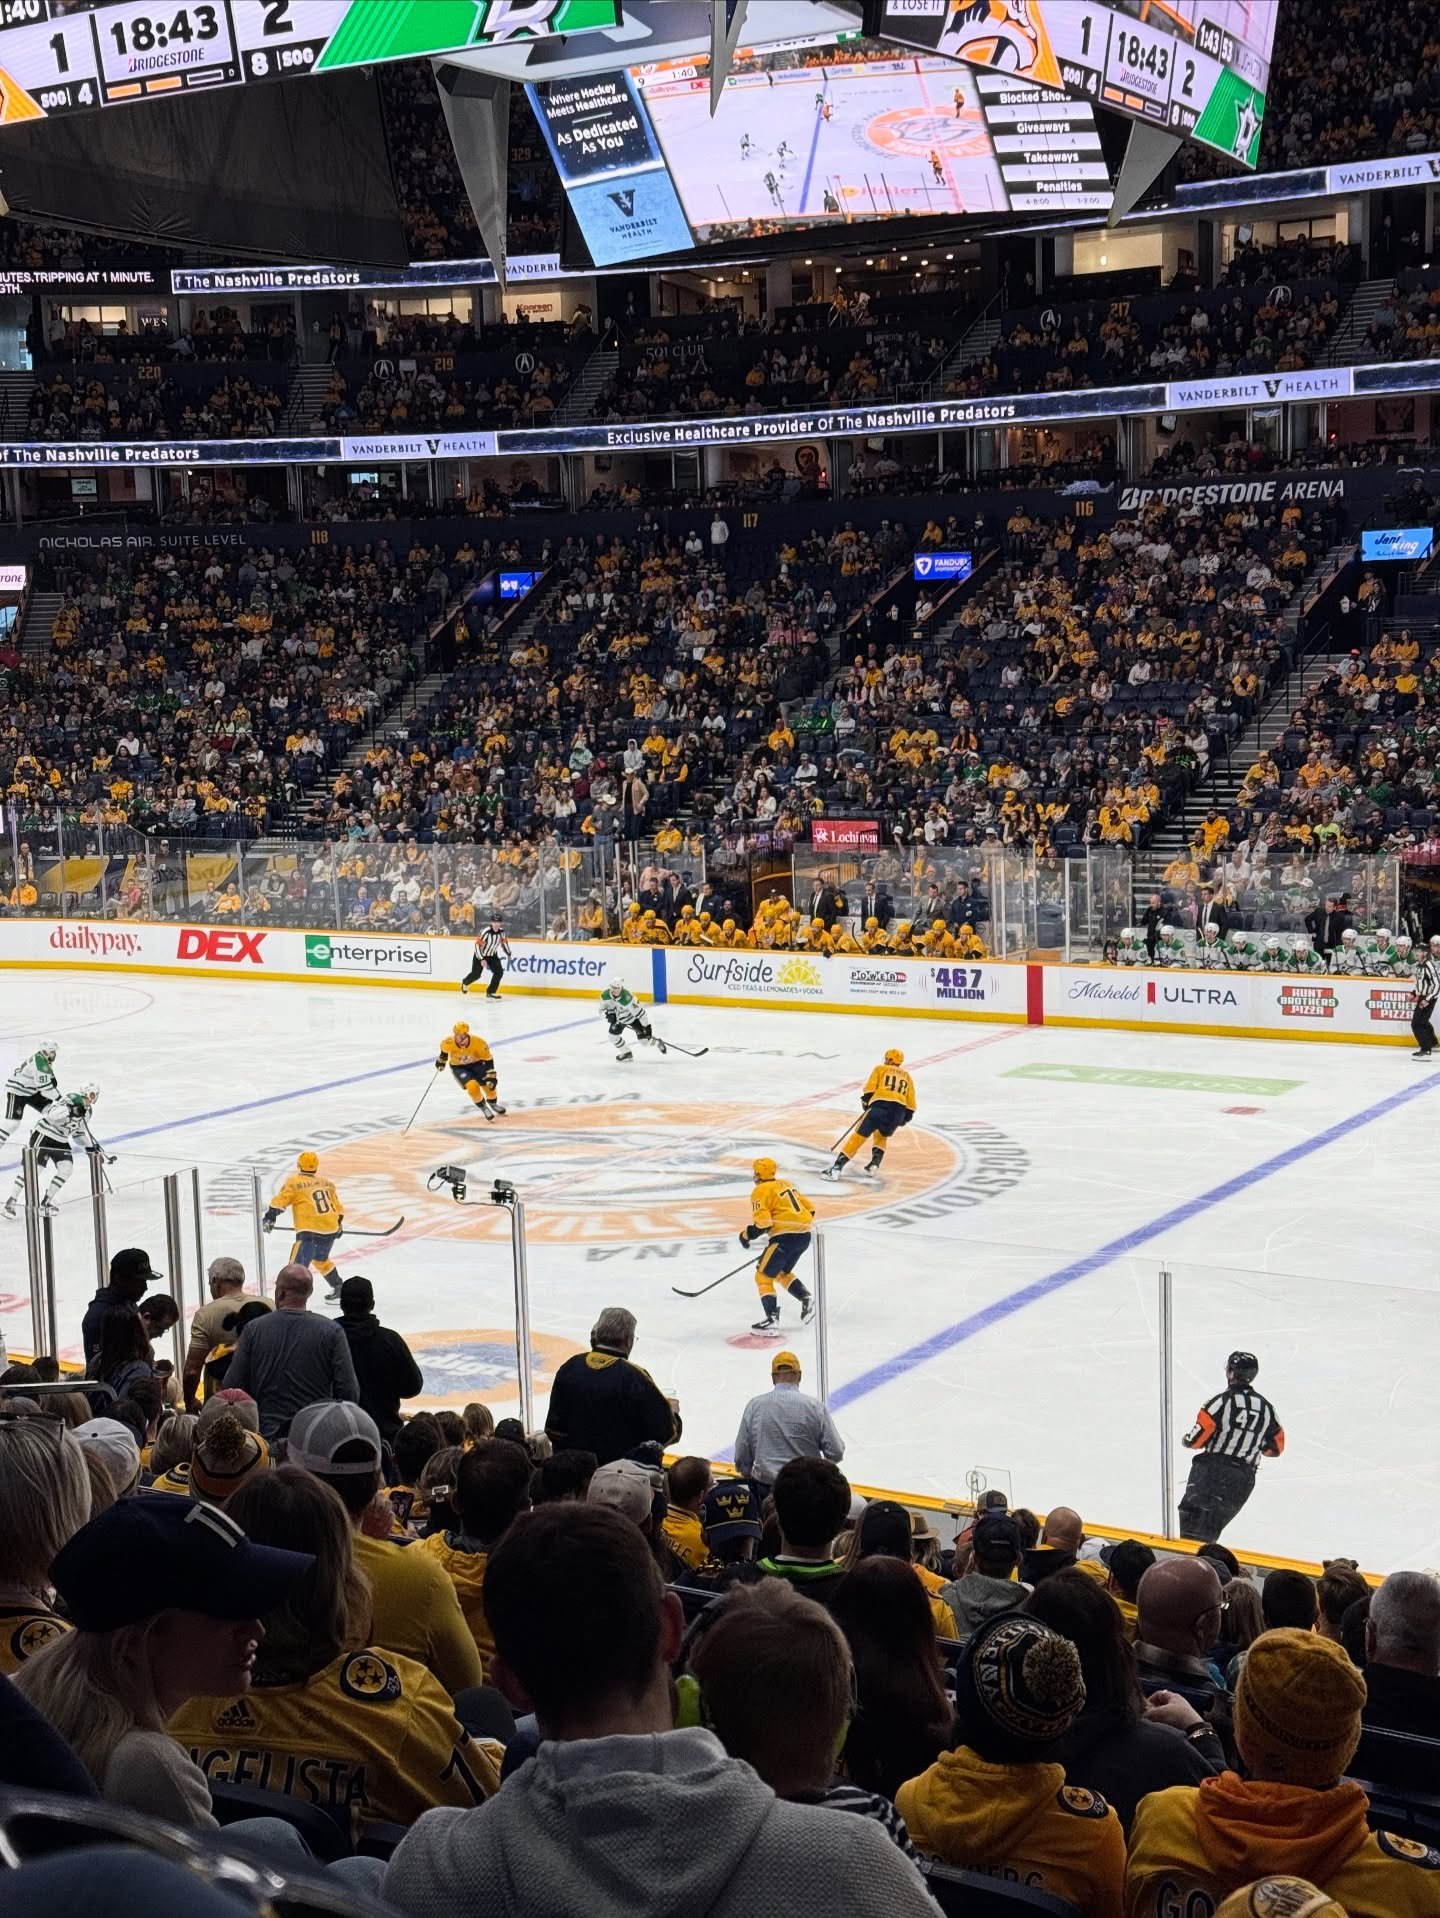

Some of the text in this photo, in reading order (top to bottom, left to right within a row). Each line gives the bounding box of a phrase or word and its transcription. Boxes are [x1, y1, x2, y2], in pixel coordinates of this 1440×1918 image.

[260, 0, 293, 36] 2
[110, 5, 219, 56] 18:43
[1081, 15, 1092, 56] 1
[50, 32, 69, 73] 1
[1200, 25, 1233, 62] 1:43 53
[128, 47, 205, 73] BRIDGESTONE
[251, 52, 269, 76] 8
[1118, 31, 1169, 80] 18:43
[672, 68, 694, 79] 1:40
[1087, 72, 1097, 95] 4
[1120, 65, 1159, 96] BRIDGESTONE
[1182, 60, 1195, 97] 2
[78, 82, 93, 105] 4
[549, 83, 616, 107] Where Hockey
[1000, 90, 1072, 104] Blocked Sho
[546, 91, 628, 119] Meets Healthcare
[557, 116, 639, 146] As Dedicated
[1016, 122, 1071, 134] Giveaways
[582, 135, 625, 155] As You
[1023, 152, 1080, 164] Takeaways
[1340, 166, 1422, 184] VANDERBILT
[1036, 181, 1083, 192] Penalties
[609, 218, 658, 233] VANDERBILT
[621, 229, 653, 240] HEALTH
[86, 271, 100, 283] AT
[102, 271, 107, 283] 1
[110, 271, 154, 283] MINUTE.
[187, 275, 210, 288] The
[214, 271, 282, 288] Nashville
[288, 270, 360, 286] Predators
[138, 366, 161, 379] 220
[434, 357, 453, 371] 219
[1178, 386, 1259, 401] VANDERBILT
[1285, 379, 1338, 393] HEALTH
[607, 405, 1015, 445] Exclusive Healthcare Provider Of The Nashville Predators
[13, 449, 41, 462] The
[46, 448, 120, 462] Nashville
[125, 447, 200, 462] Predators
[352, 443, 422, 455] VANDERBILT
[443, 441, 486, 451] HEALTH
[1280, 479, 1344, 500] ARENA
[1075, 500, 1094, 517] 116
[743, 513, 758, 528] 117
[39, 536, 122, 549] NICHOLAS
[160, 535, 200, 547] SUITE
[204, 534, 246, 546] LEVEL
[311, 530, 328, 544] 118
[176, 929, 268, 964] DEX
[313, 943, 428, 965] enterprise
[500, 953, 606, 976] cketmaster
[687, 953, 773, 984] Surfside
[936, 988, 985, 1000] MILLION
[1068, 980, 1238, 1005] Michelob ULTRA
[1280, 996, 1336, 1007] BROTHERS
[1291, 988, 1324, 999] HUNT
[1290, 1006, 1324, 1015] PIZZA
[1368, 1000, 1417, 1010] BROTHE
[39, 1075, 48, 1084] 91
[884, 1074, 909, 1096] 48
[1235, 1410, 1260, 1430] 47
[217, 1718, 255, 1729] adidas
